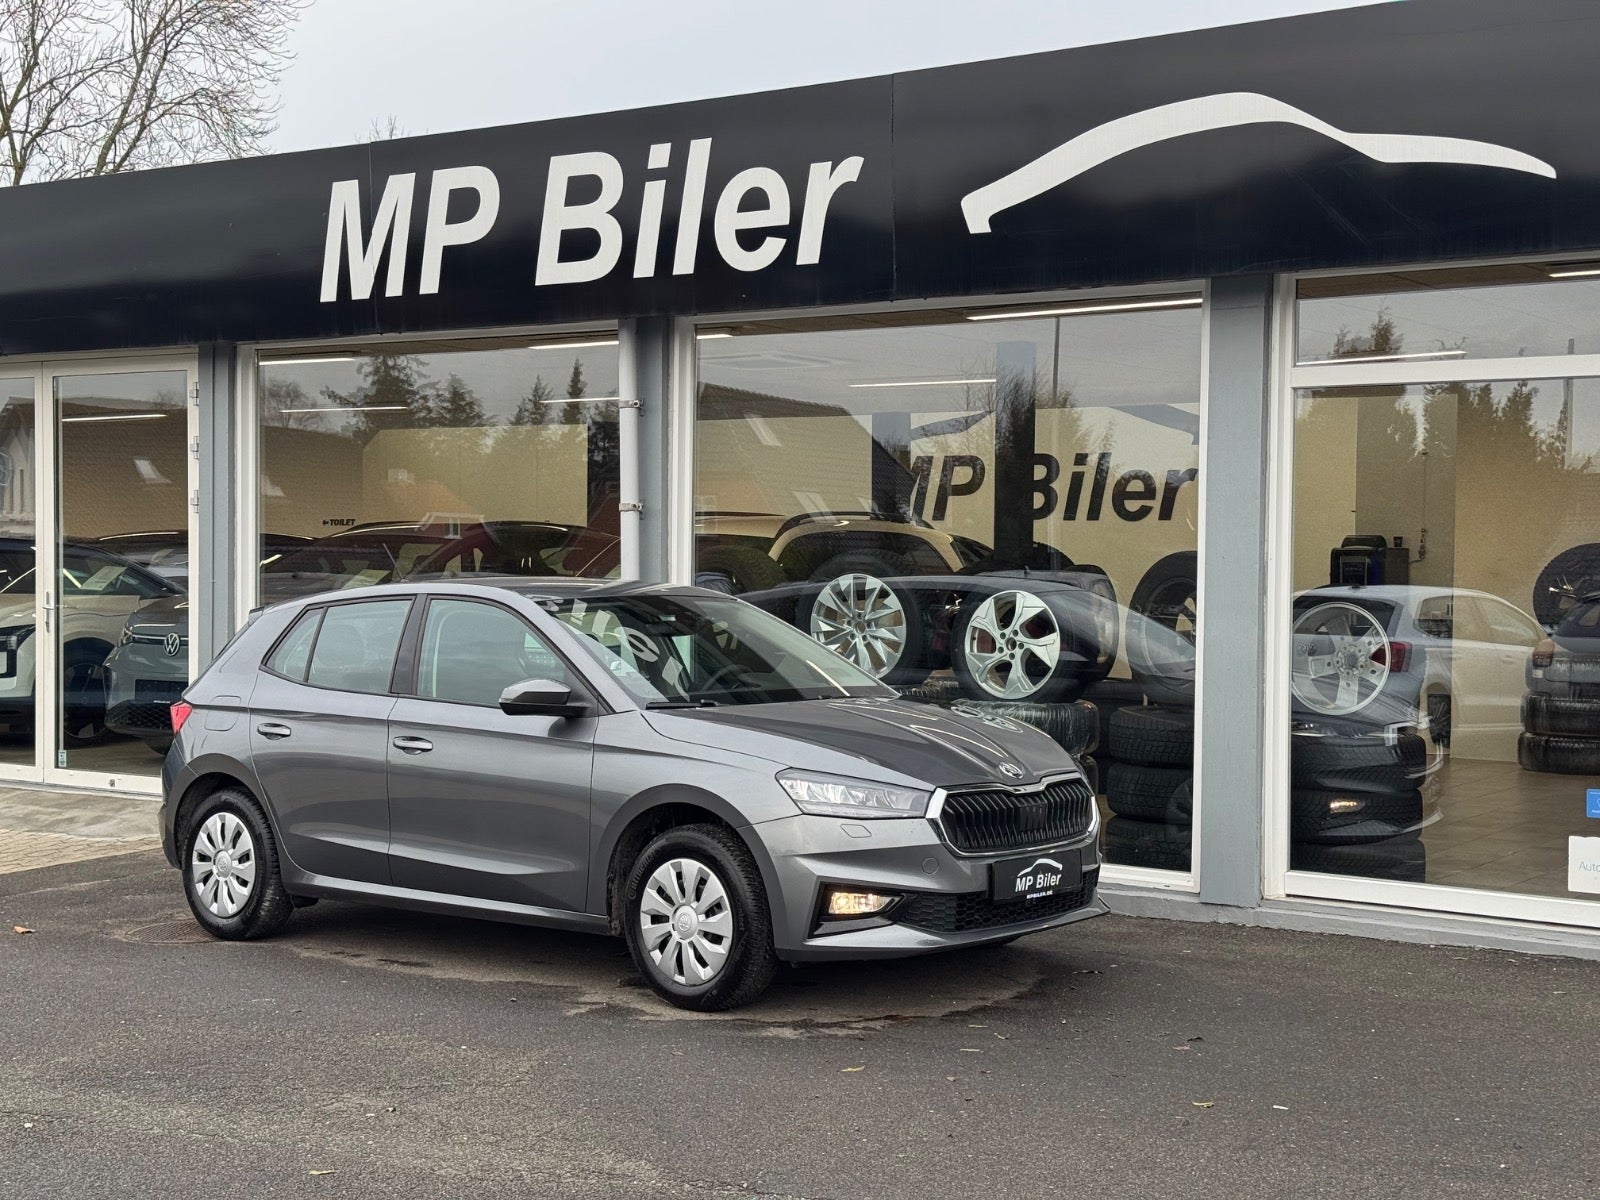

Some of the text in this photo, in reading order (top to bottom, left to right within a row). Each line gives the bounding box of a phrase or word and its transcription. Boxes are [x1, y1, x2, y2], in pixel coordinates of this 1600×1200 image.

[320, 137, 865, 302] MP Biler
[329, 518, 356, 526] TOILET
[1015, 872, 1061, 892] MP Biler
